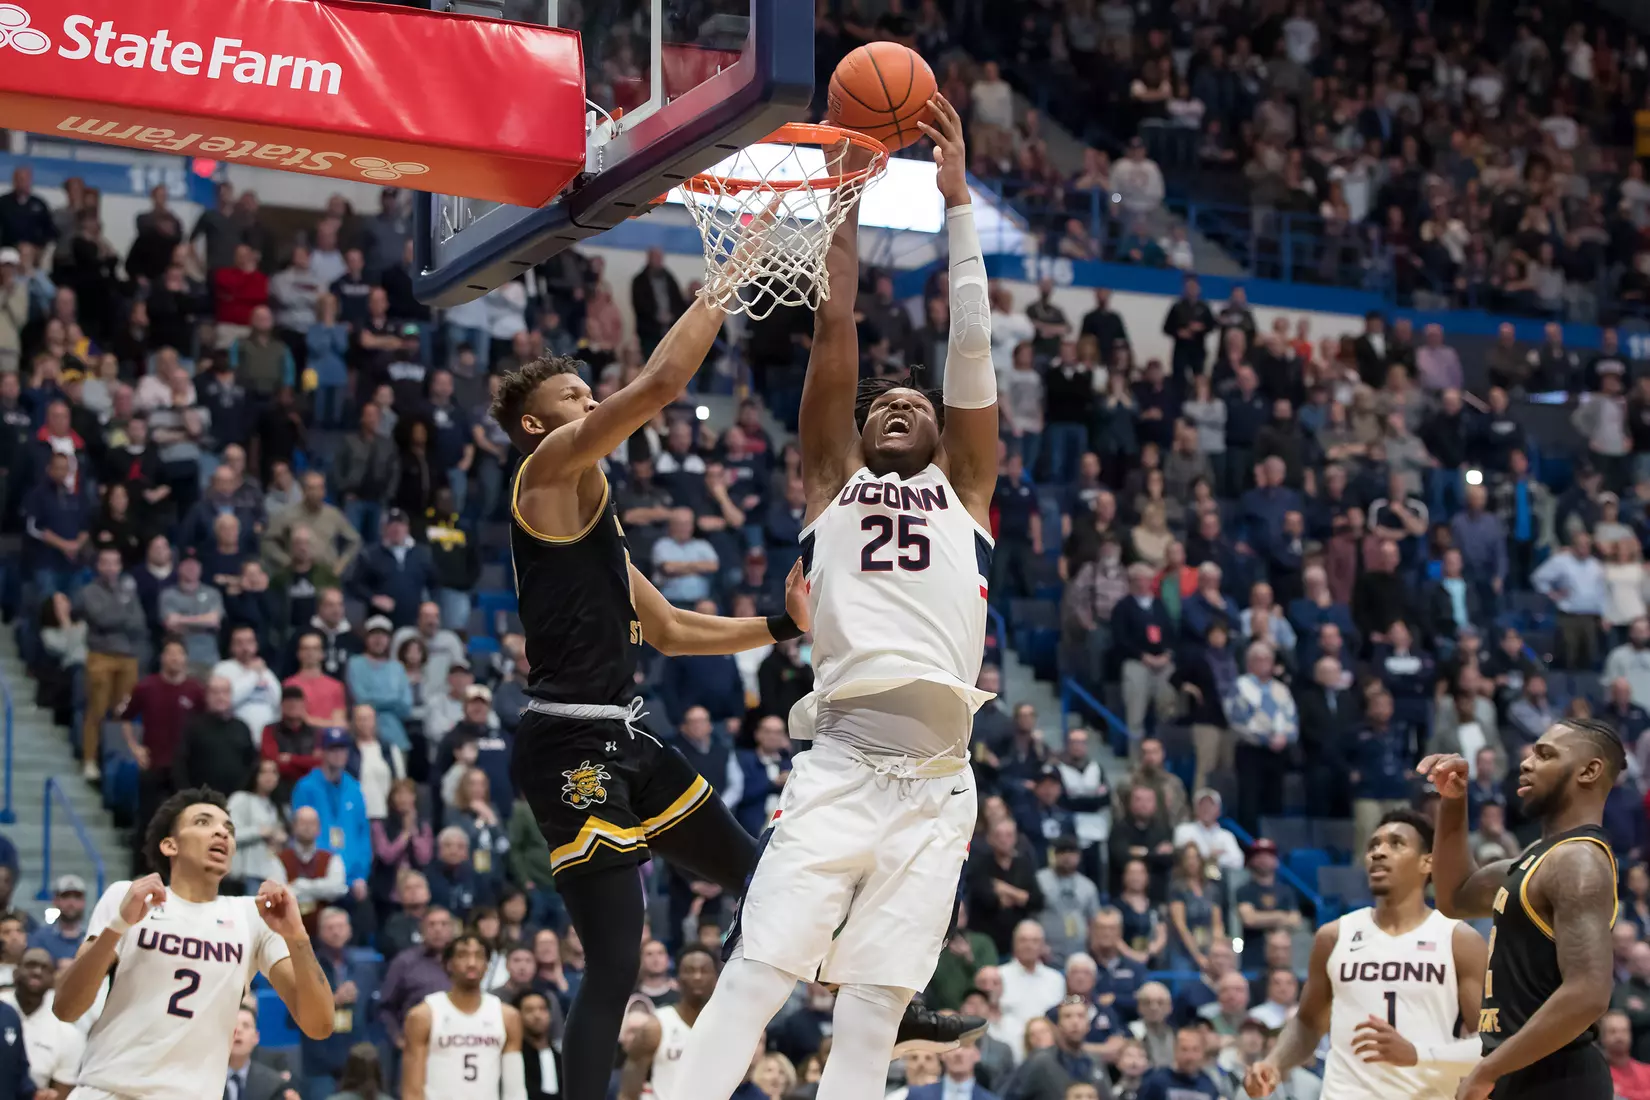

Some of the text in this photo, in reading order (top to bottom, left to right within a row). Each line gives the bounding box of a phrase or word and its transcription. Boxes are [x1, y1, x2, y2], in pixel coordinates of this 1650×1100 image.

[838, 482, 949, 512] UCONN
[861, 514, 931, 572] 25
[137, 927, 243, 965] UCONN
[1340, 961, 1446, 985] UCONN
[167, 968, 202, 1020] 2
[1383, 991, 1397, 1030] 1
[438, 1033, 500, 1049] UCONN
[463, 1052, 478, 1082] 5
